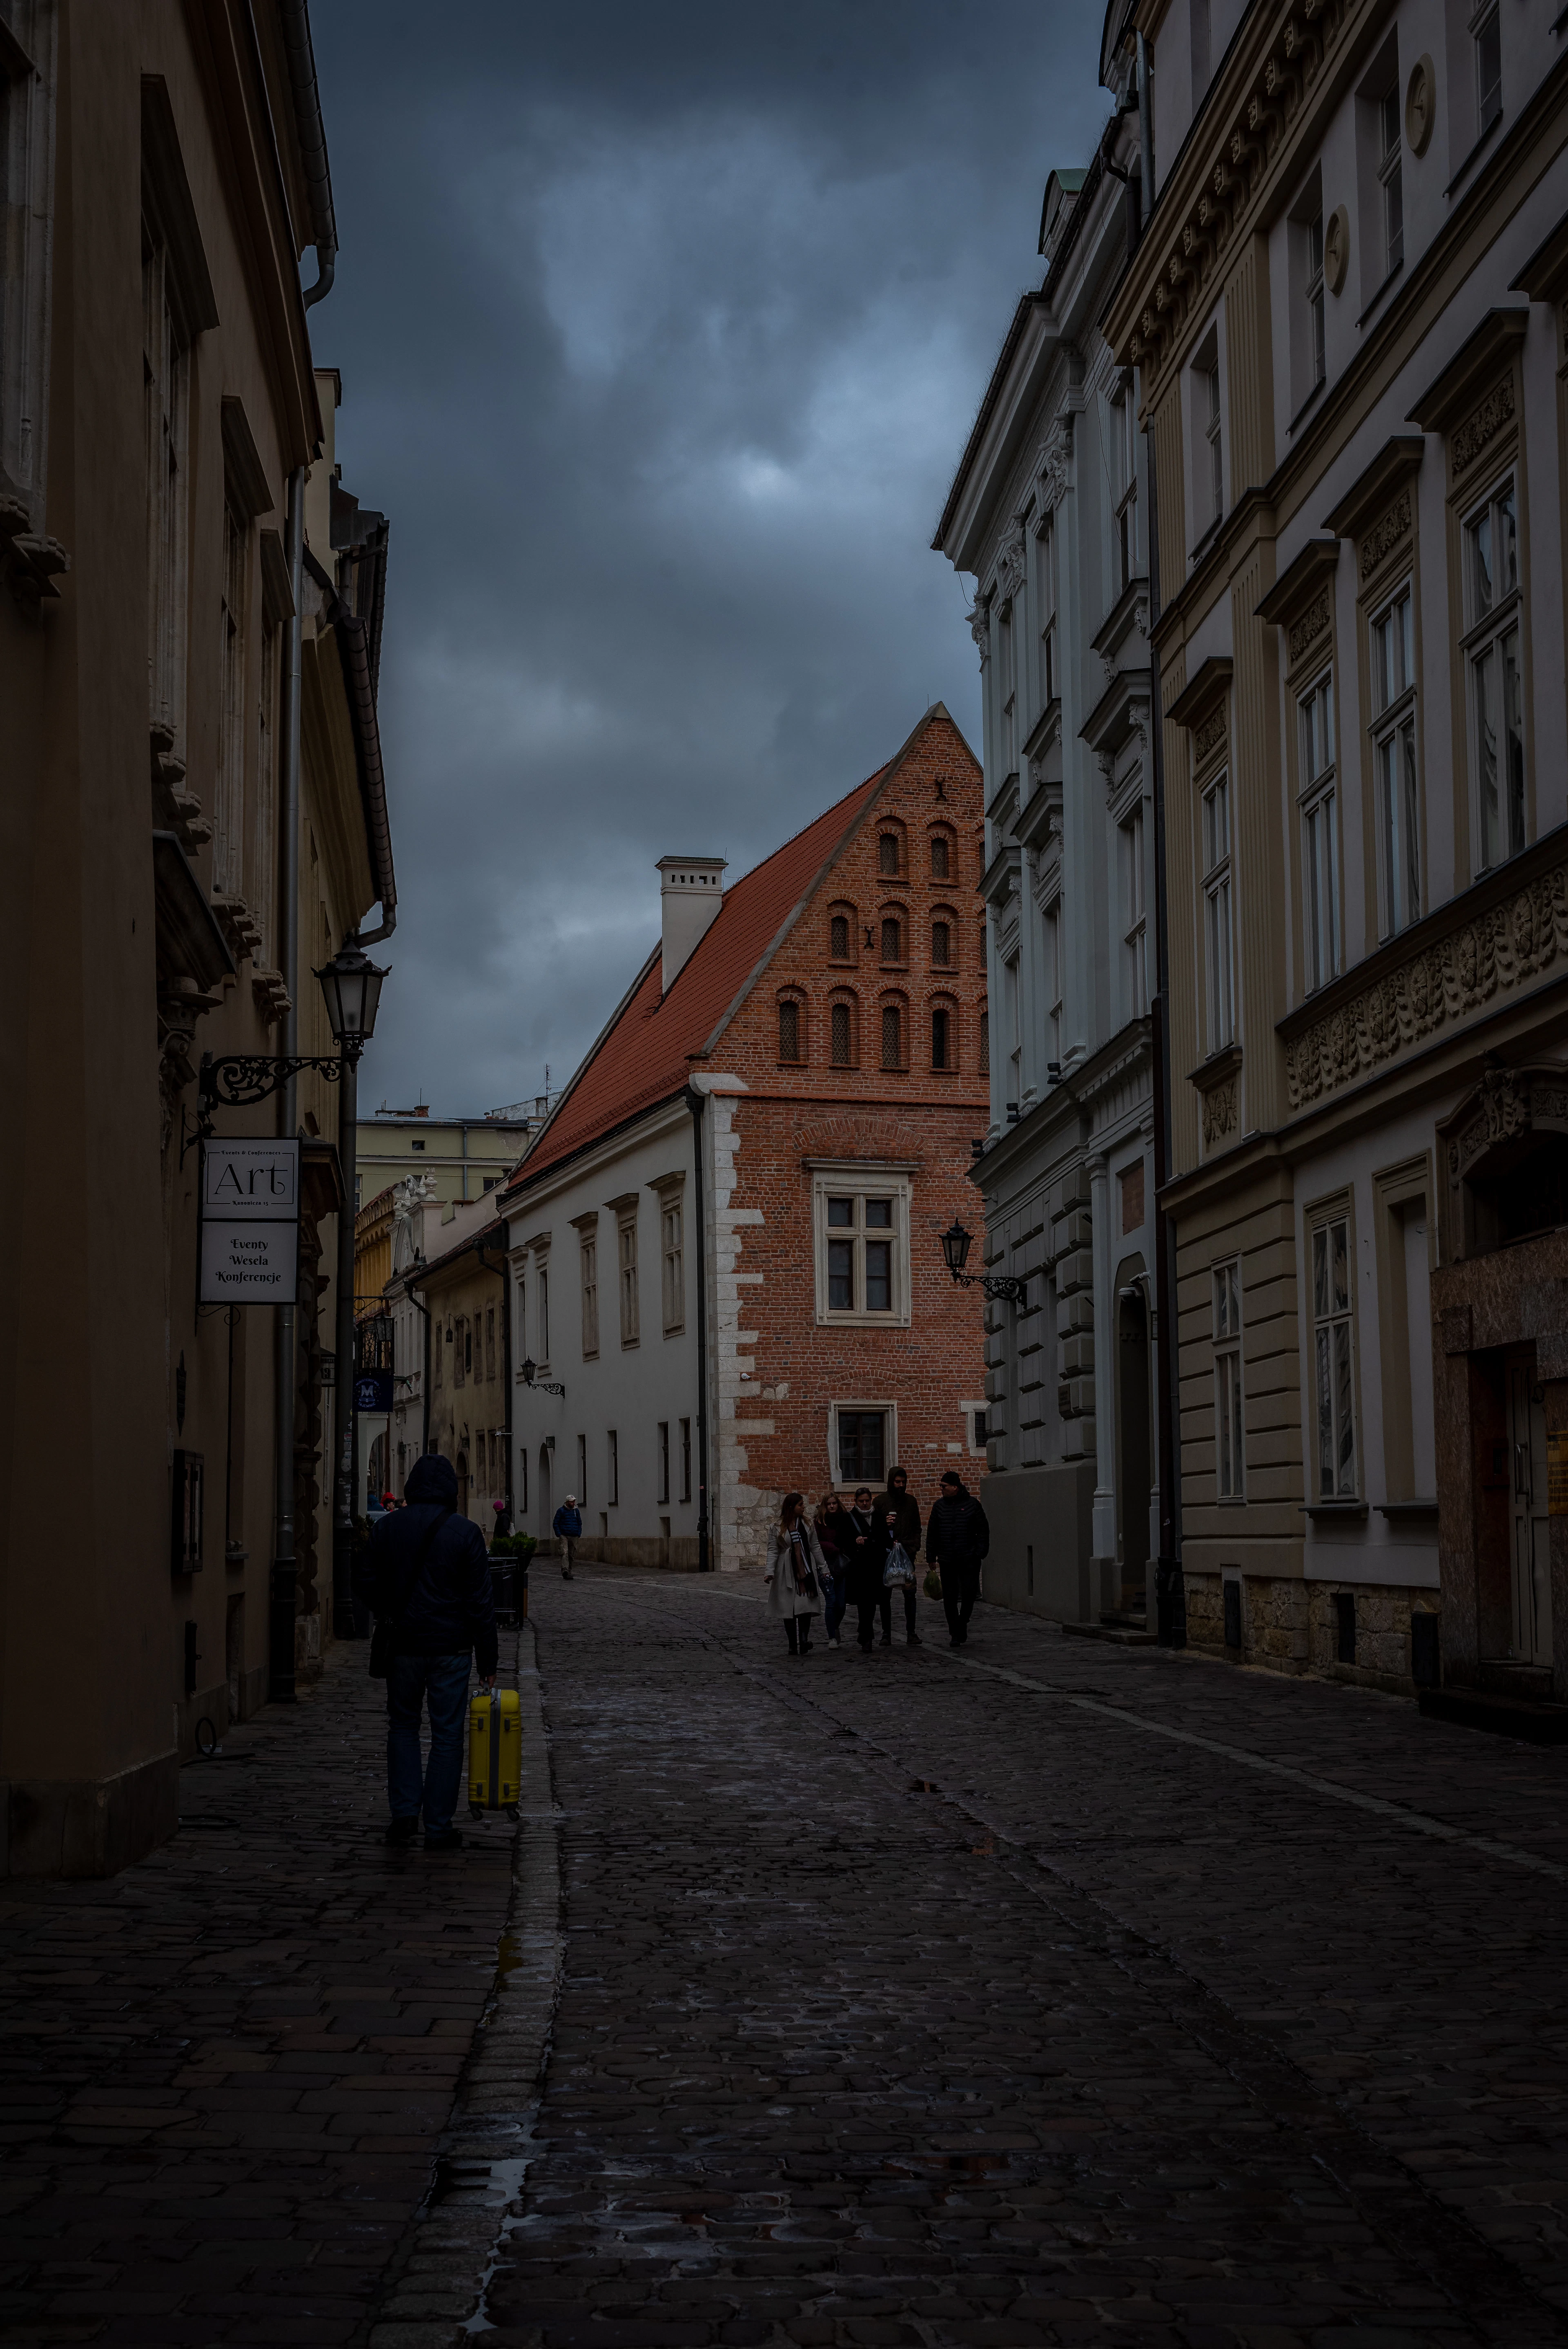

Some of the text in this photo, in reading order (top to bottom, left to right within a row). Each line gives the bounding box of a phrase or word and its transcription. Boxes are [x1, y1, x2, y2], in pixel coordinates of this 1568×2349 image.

[213, 1159, 289, 1195] Art
[230, 1239, 268, 1252] Eventy
[229, 1255, 269, 1266] Wesela
[215, 1270, 282, 1285] Konferencje
[361, 1385, 374, 1396] M
